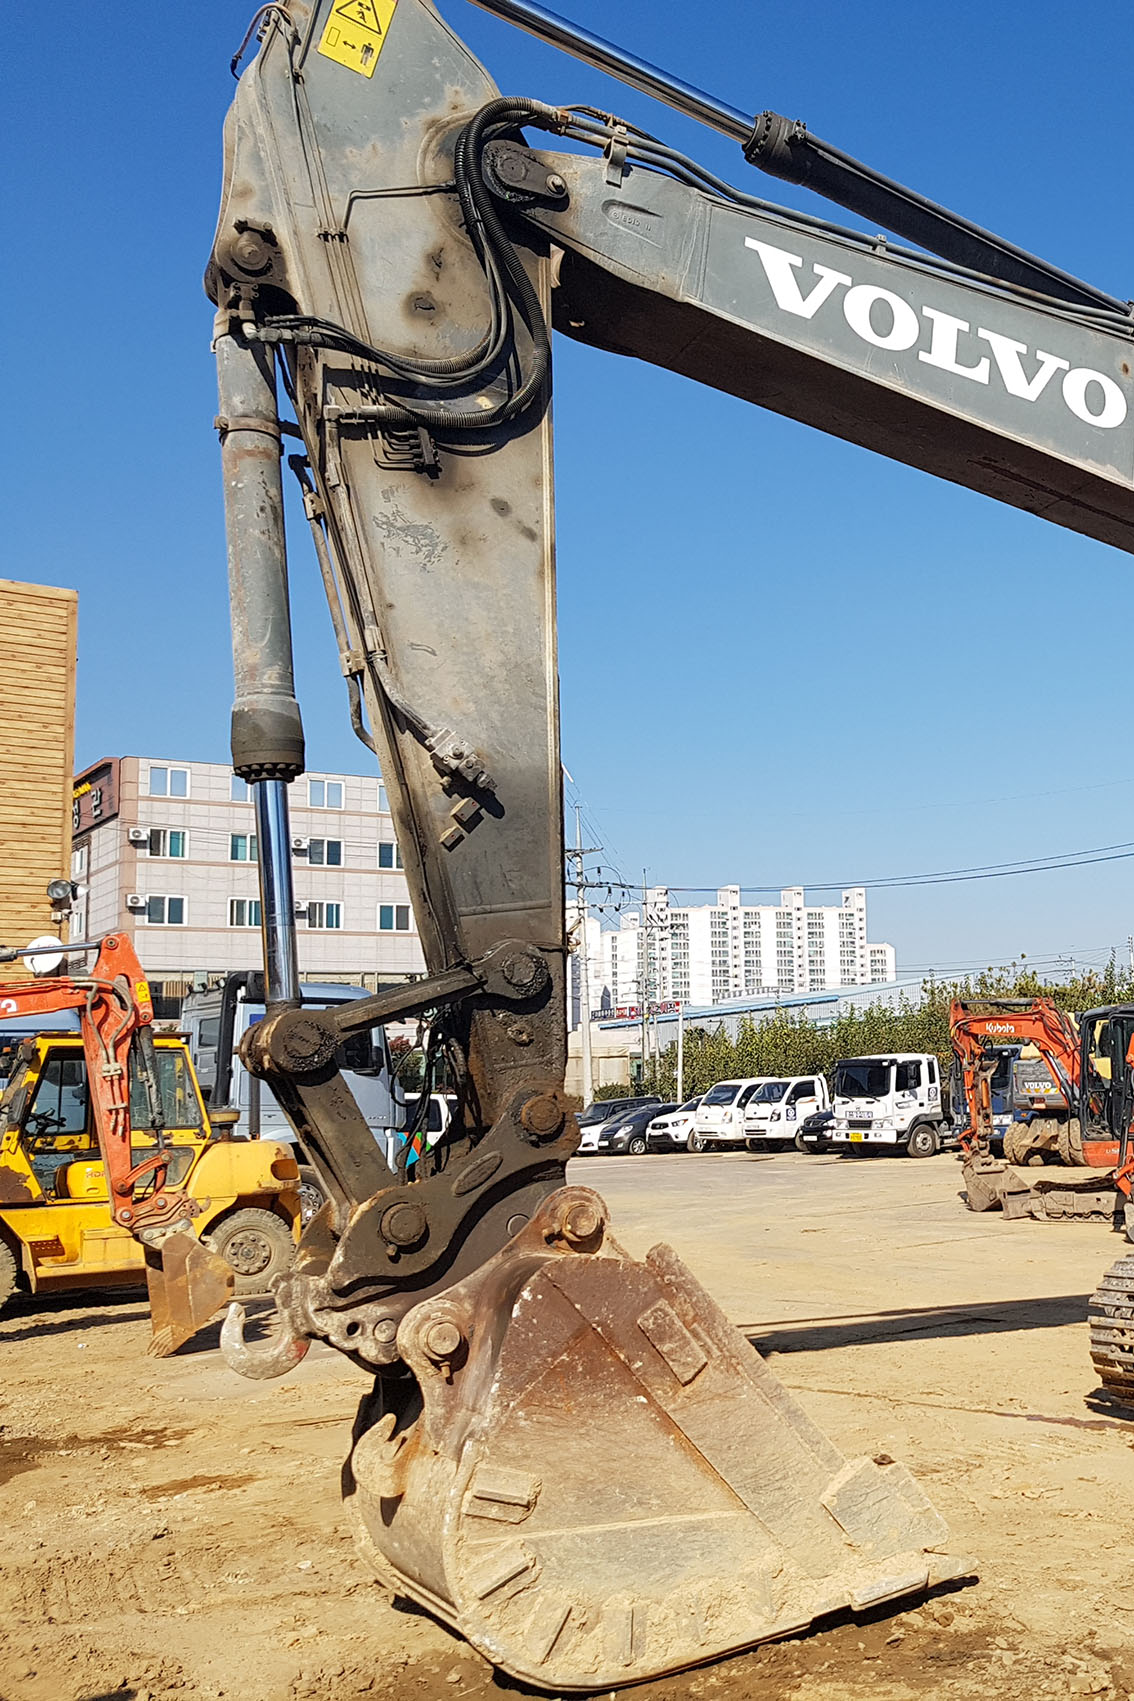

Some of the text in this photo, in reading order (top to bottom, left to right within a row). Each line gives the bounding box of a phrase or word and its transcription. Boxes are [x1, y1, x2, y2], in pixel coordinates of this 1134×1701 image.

[744, 236, 1128, 429] VOLVO
[985, 1022, 1015, 1033] Kubota
[1024, 1081, 1052, 1089] VOLVO
